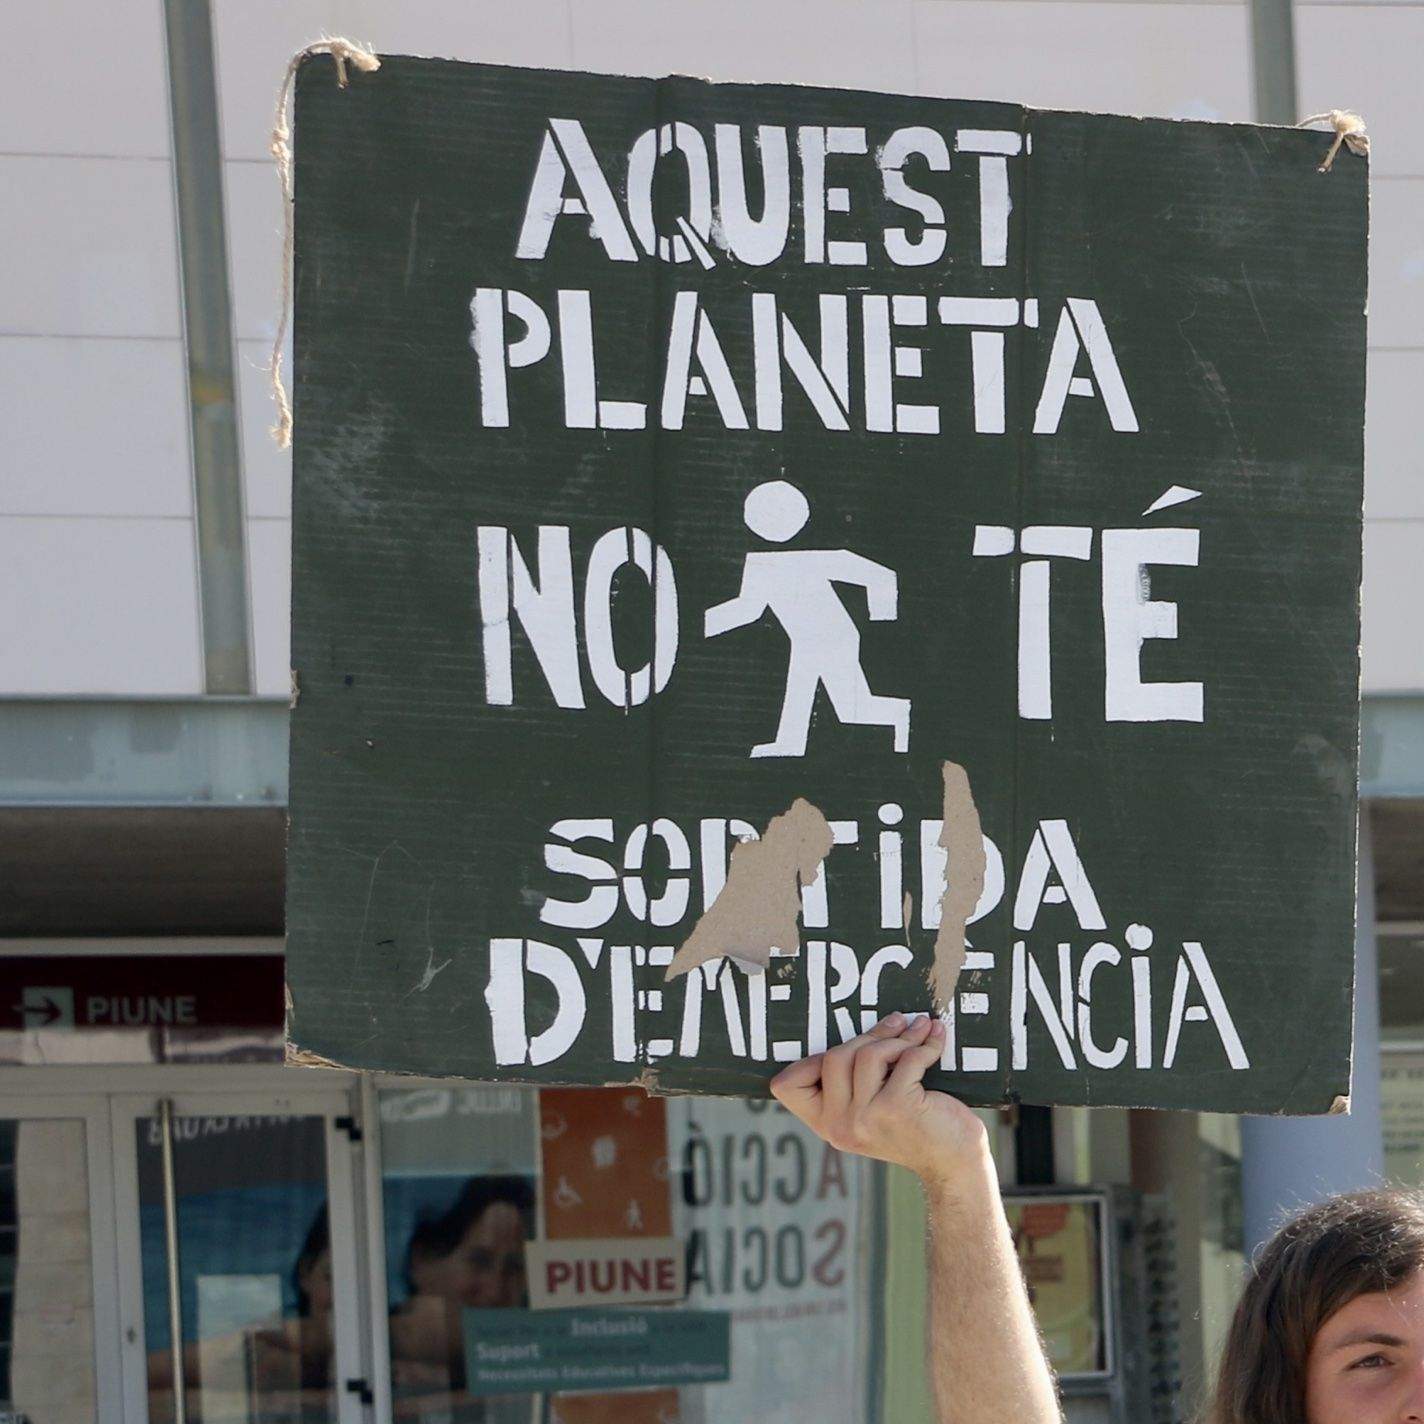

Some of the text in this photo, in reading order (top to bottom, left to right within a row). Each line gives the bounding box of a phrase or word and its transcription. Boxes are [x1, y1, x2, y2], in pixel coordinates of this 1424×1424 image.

[513, 117, 1031, 269] AQUEST
[469, 287, 1140, 435] PLANETA
[477, 485, 1204, 723] NO TÉ
[86, 996, 198, 1023] PIUNE
[545, 1257, 677, 1294] PIUNE
[475, 1341, 542, 1363] Suport
